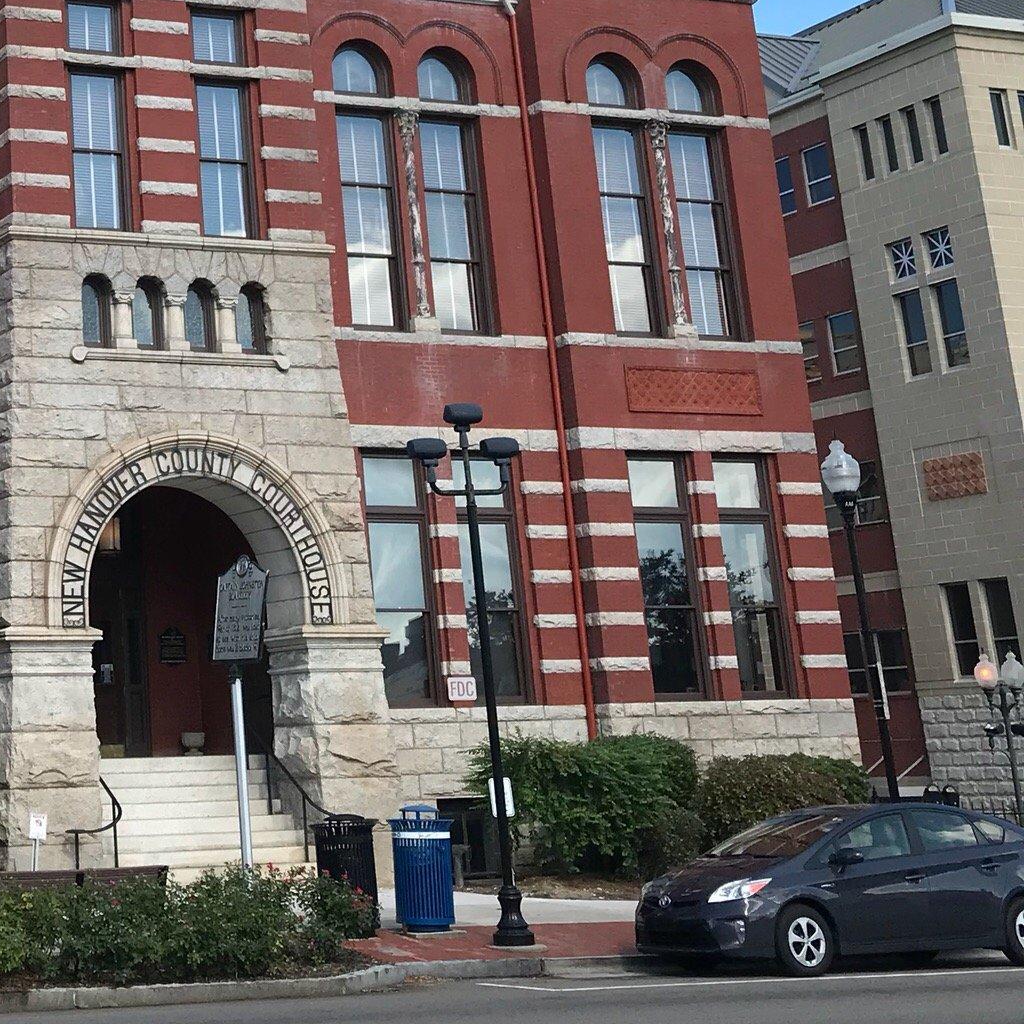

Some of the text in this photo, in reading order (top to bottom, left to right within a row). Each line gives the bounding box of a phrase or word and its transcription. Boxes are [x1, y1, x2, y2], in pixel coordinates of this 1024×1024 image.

[62, 448, 333, 618] NEW HANOVER COUNTY COURTHOUSE
[450, 681, 474, 697] FDC
